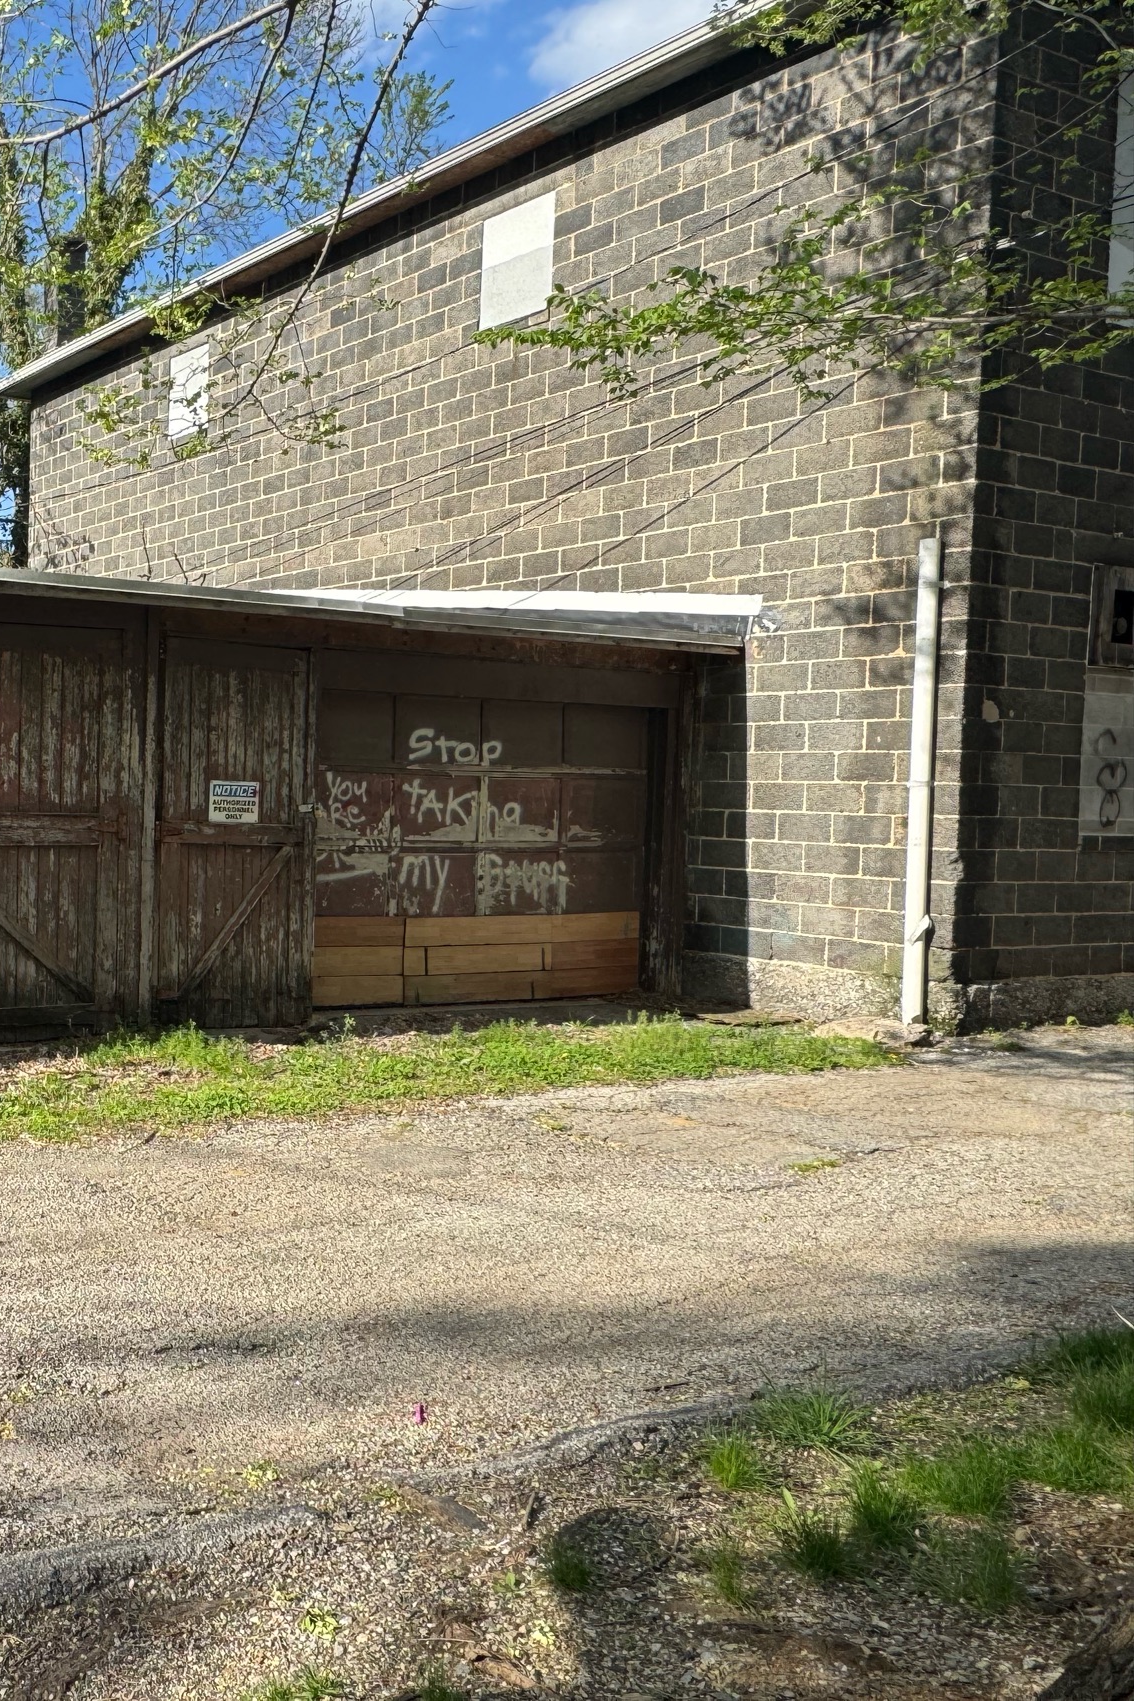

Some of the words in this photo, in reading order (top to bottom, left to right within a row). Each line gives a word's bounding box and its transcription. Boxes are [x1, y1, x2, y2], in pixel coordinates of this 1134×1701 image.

[408, 728, 503, 765] Stop
[214, 785, 255, 796] NOTICE
[212, 799, 256, 807] AUTHORIZED
